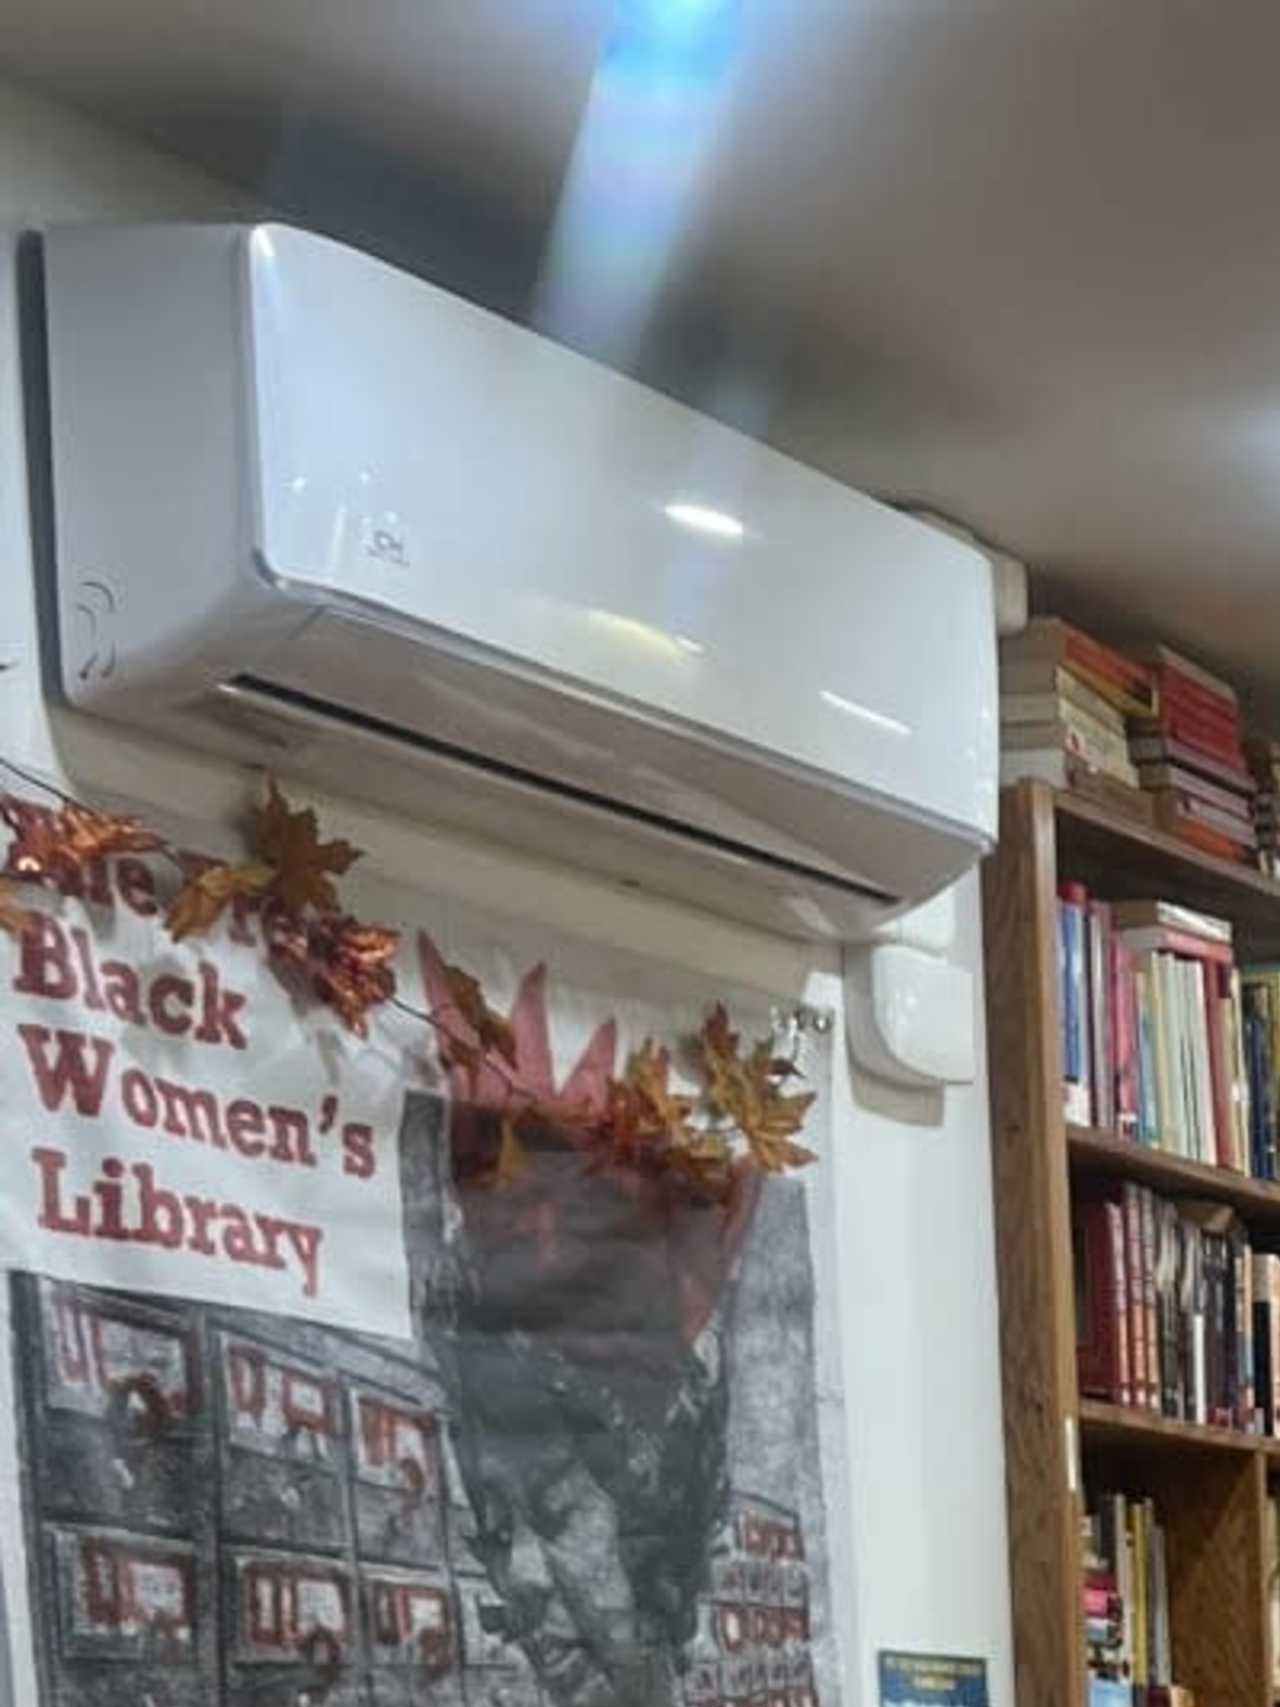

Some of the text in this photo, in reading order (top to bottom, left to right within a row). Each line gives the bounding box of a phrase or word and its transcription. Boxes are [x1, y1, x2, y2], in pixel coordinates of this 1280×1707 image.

[14, 910, 248, 1050] Black
[16, 1023, 375, 1178] Women's
[31, 1146, 323, 1297] Library
